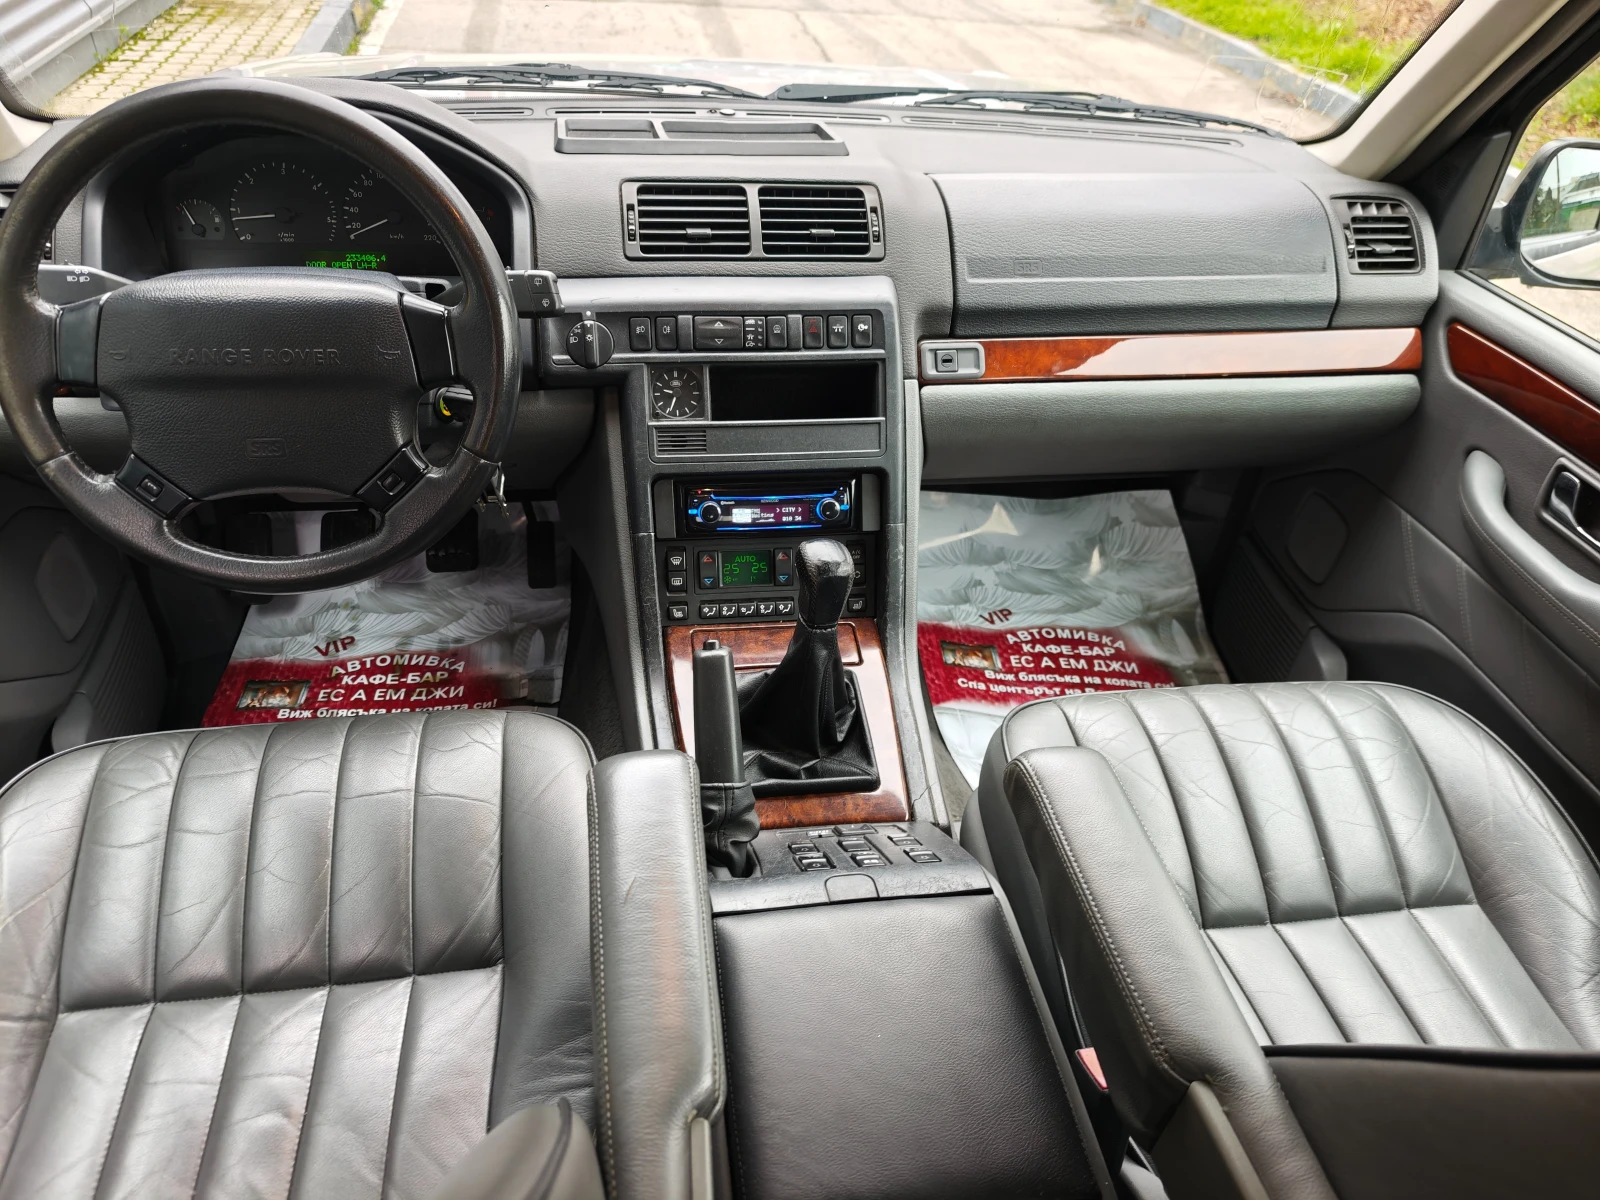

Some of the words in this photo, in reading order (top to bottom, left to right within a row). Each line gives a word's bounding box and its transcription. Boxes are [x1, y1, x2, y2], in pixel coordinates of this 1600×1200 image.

[332, 261, 353, 269] OPEN
[169, 348, 251, 365] RANGE
[263, 348, 341, 365] ROVER
[734, 555, 756, 563] AUTO
[979, 608, 1012, 626] VIP
[314, 635, 356, 657] VIP
[1006, 627, 1126, 651] АВТОМИВКА
[1022, 643, 1115, 657] КАФЕ-БАР
[330, 653, 465, 678] АВТОМИВКА
[1010, 655, 1034, 668] ЕС
[1041, 657, 1056, 669] А
[1059, 658, 1088, 670] ЕМ
[1094, 660, 1139, 674] ДЖИ
[341, 672, 449, 685] КАФЕ-БАР
[984, 670, 1016, 681] Виж
[957, 678, 986, 690] Спа
[317, 689, 345, 702] ЕС
[350, 689, 367, 701] А
[374, 688, 406, 701] ЕМ
[410, 686, 465, 701] ДЖИ
[277, 708, 312, 719] Виж
